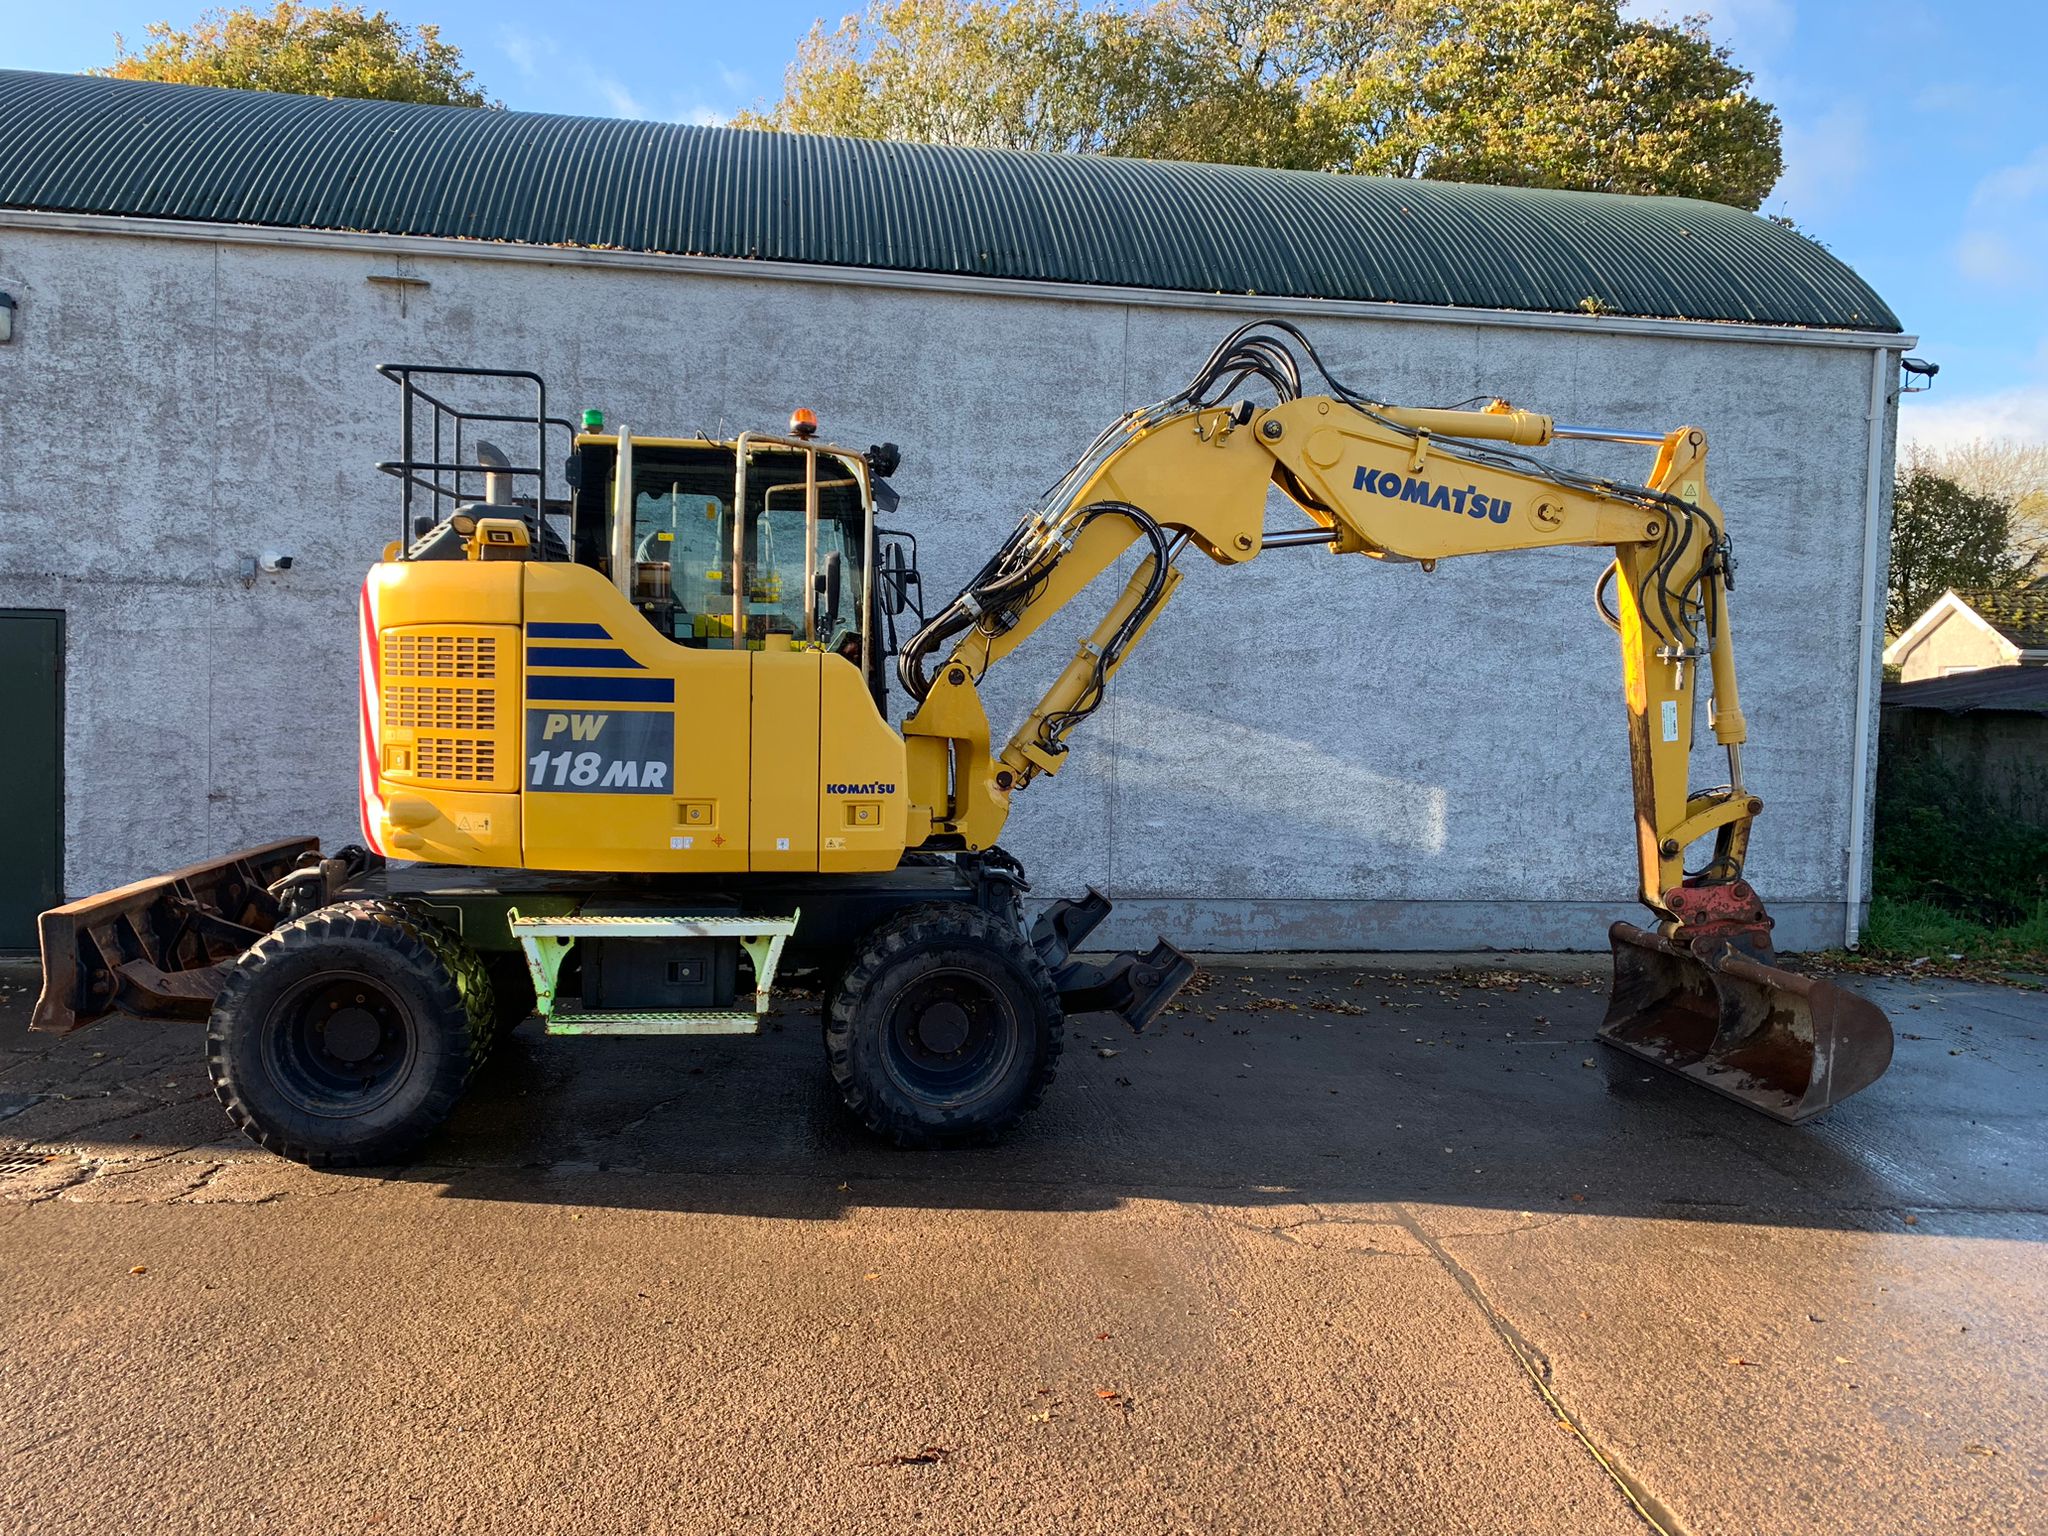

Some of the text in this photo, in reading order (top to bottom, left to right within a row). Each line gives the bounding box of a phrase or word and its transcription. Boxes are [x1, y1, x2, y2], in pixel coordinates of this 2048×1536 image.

[1353, 465, 1512, 524] KOMATSU
[543, 714, 609, 741] PW
[826, 781, 896, 794] KOMATSU
